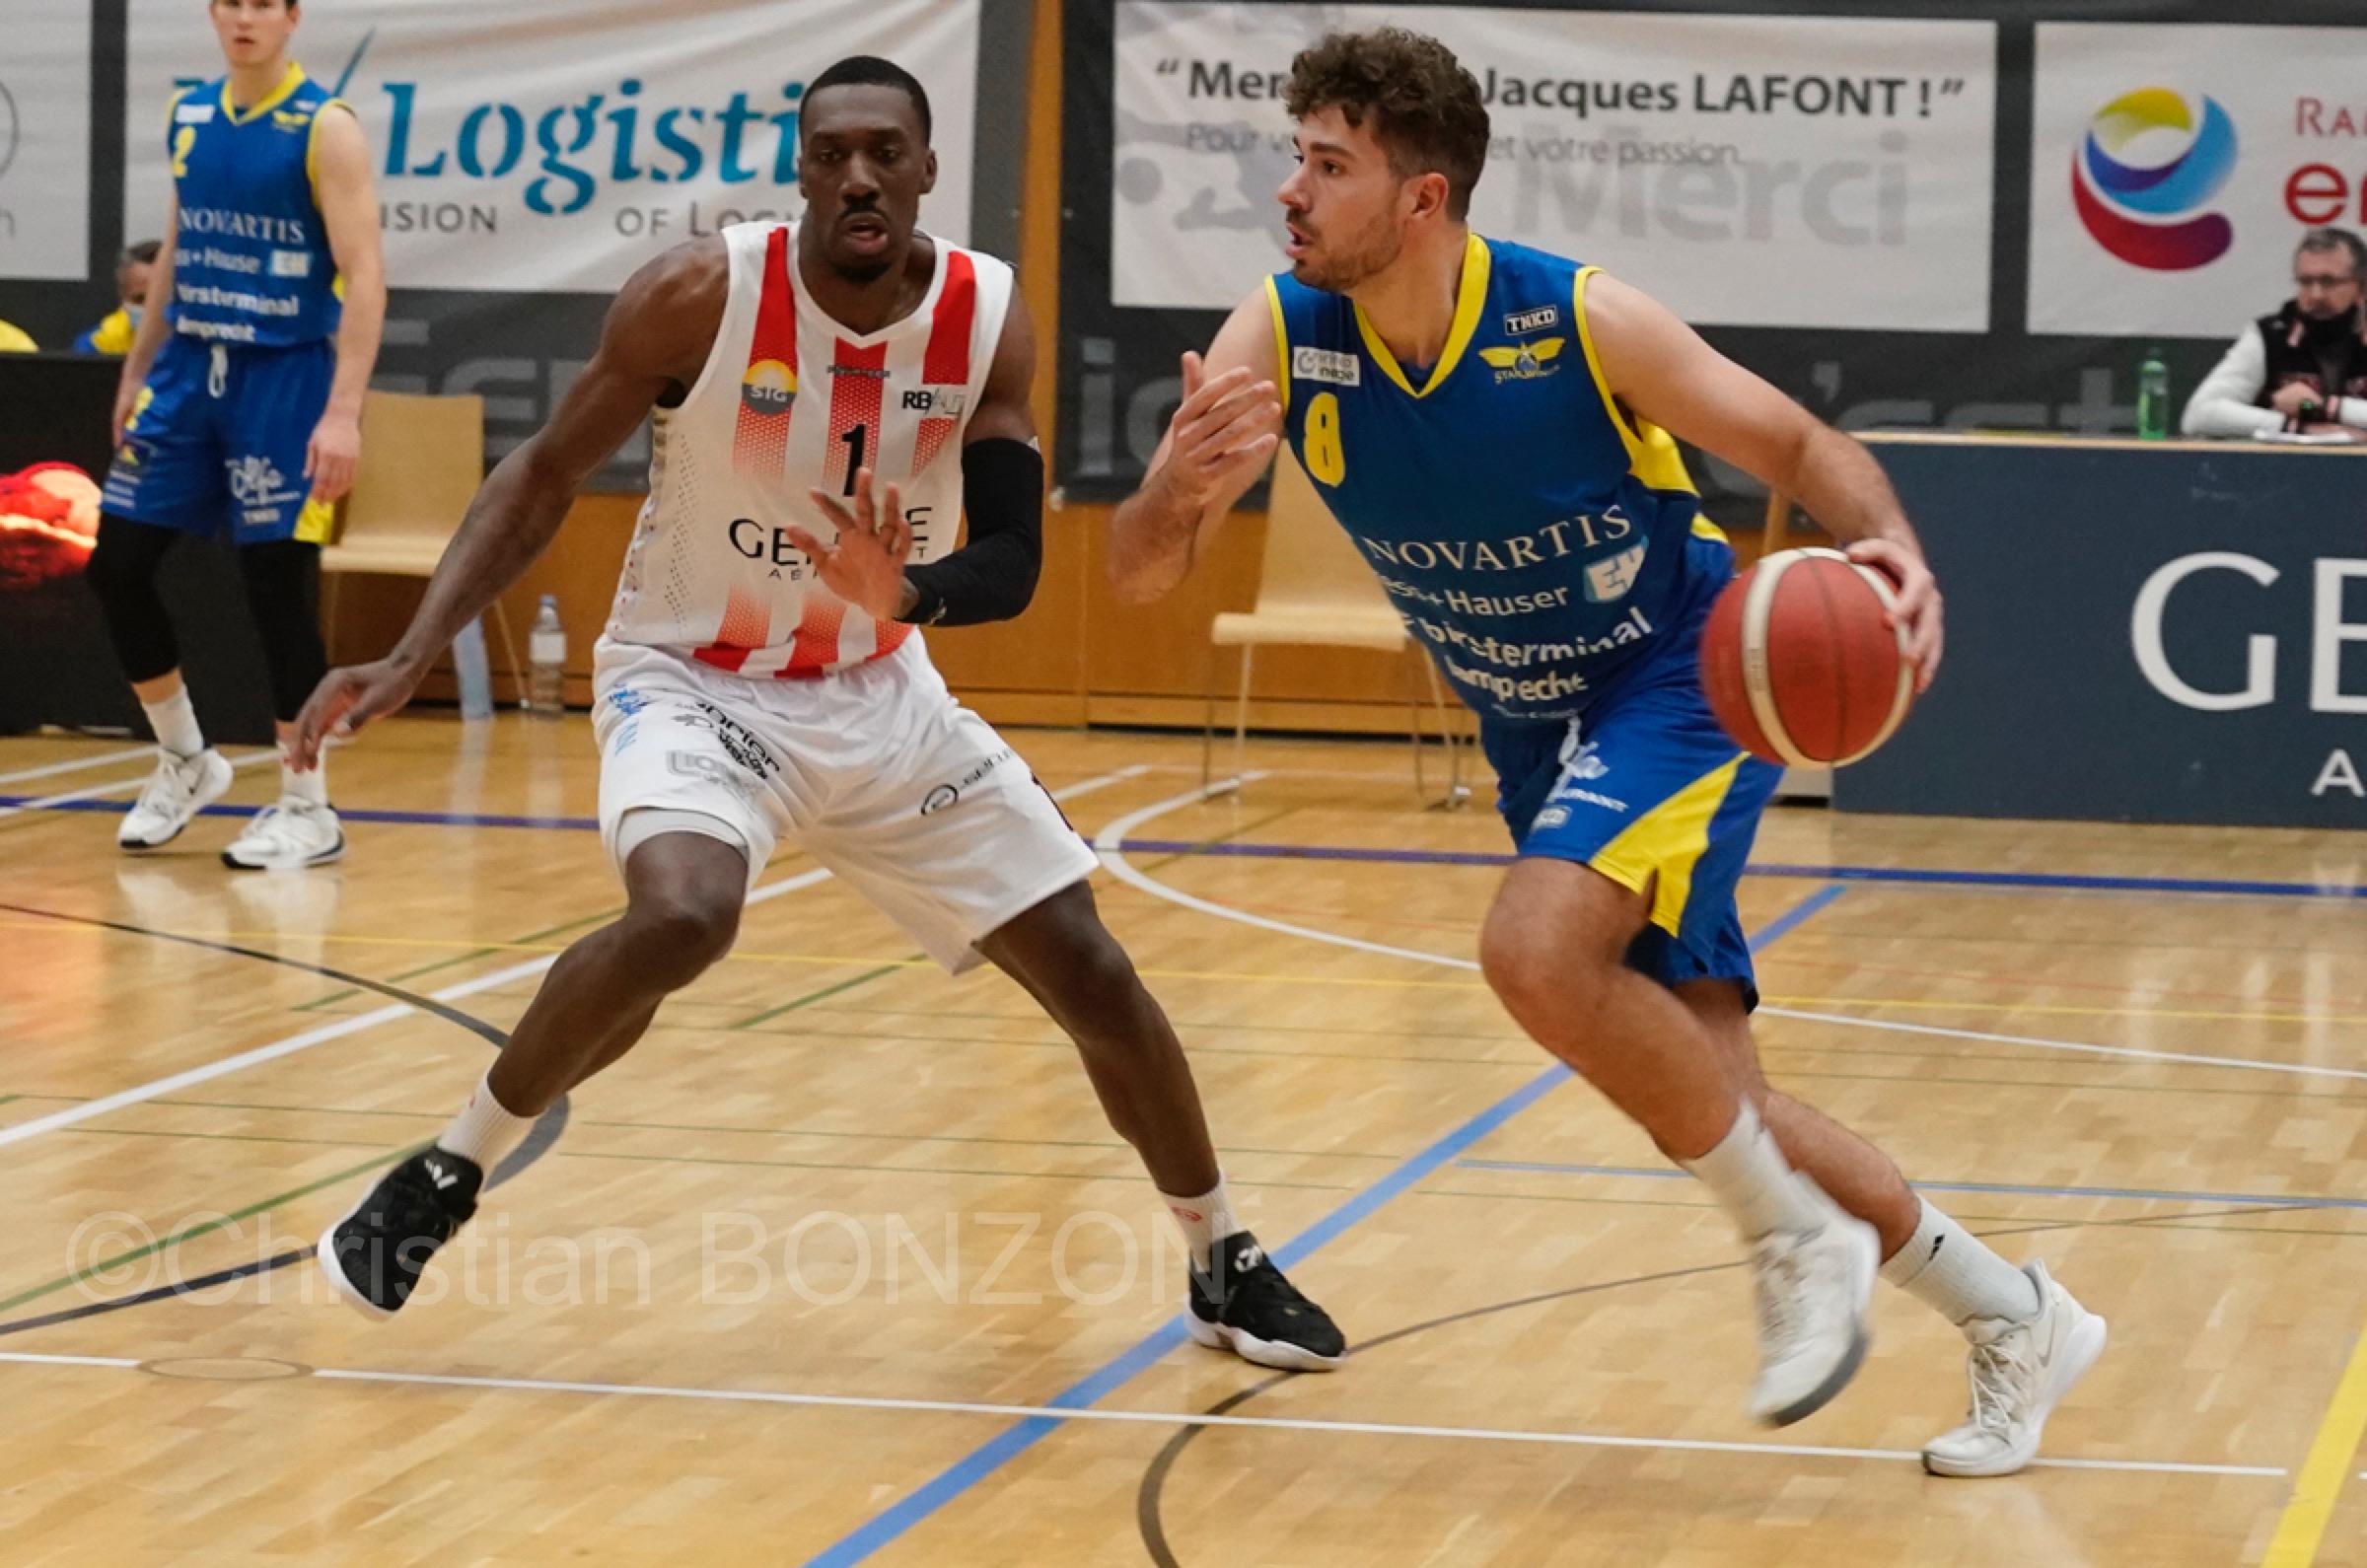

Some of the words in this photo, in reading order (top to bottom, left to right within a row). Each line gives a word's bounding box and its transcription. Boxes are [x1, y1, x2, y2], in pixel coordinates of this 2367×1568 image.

[1156, 59, 1286, 100] “Mer
[1481, 67, 1680, 117] Jacques
[1693, 74, 1905, 115] LAFONT
[383, 78, 804, 215] Logisti
[1526, 135, 1611, 164] votre
[1514, 122, 1908, 247] Merci
[179, 206, 306, 245] NOVARTIS
[380, 202, 497, 233] ISION
[615, 206, 670, 237] OF
[751, 386, 788, 402] SIG
[841, 423, 867, 496] 1
[1303, 392, 1346, 487] 8
[1360, 504, 1631, 571] NOVARTIS
[1444, 585, 1569, 617] Hauser
